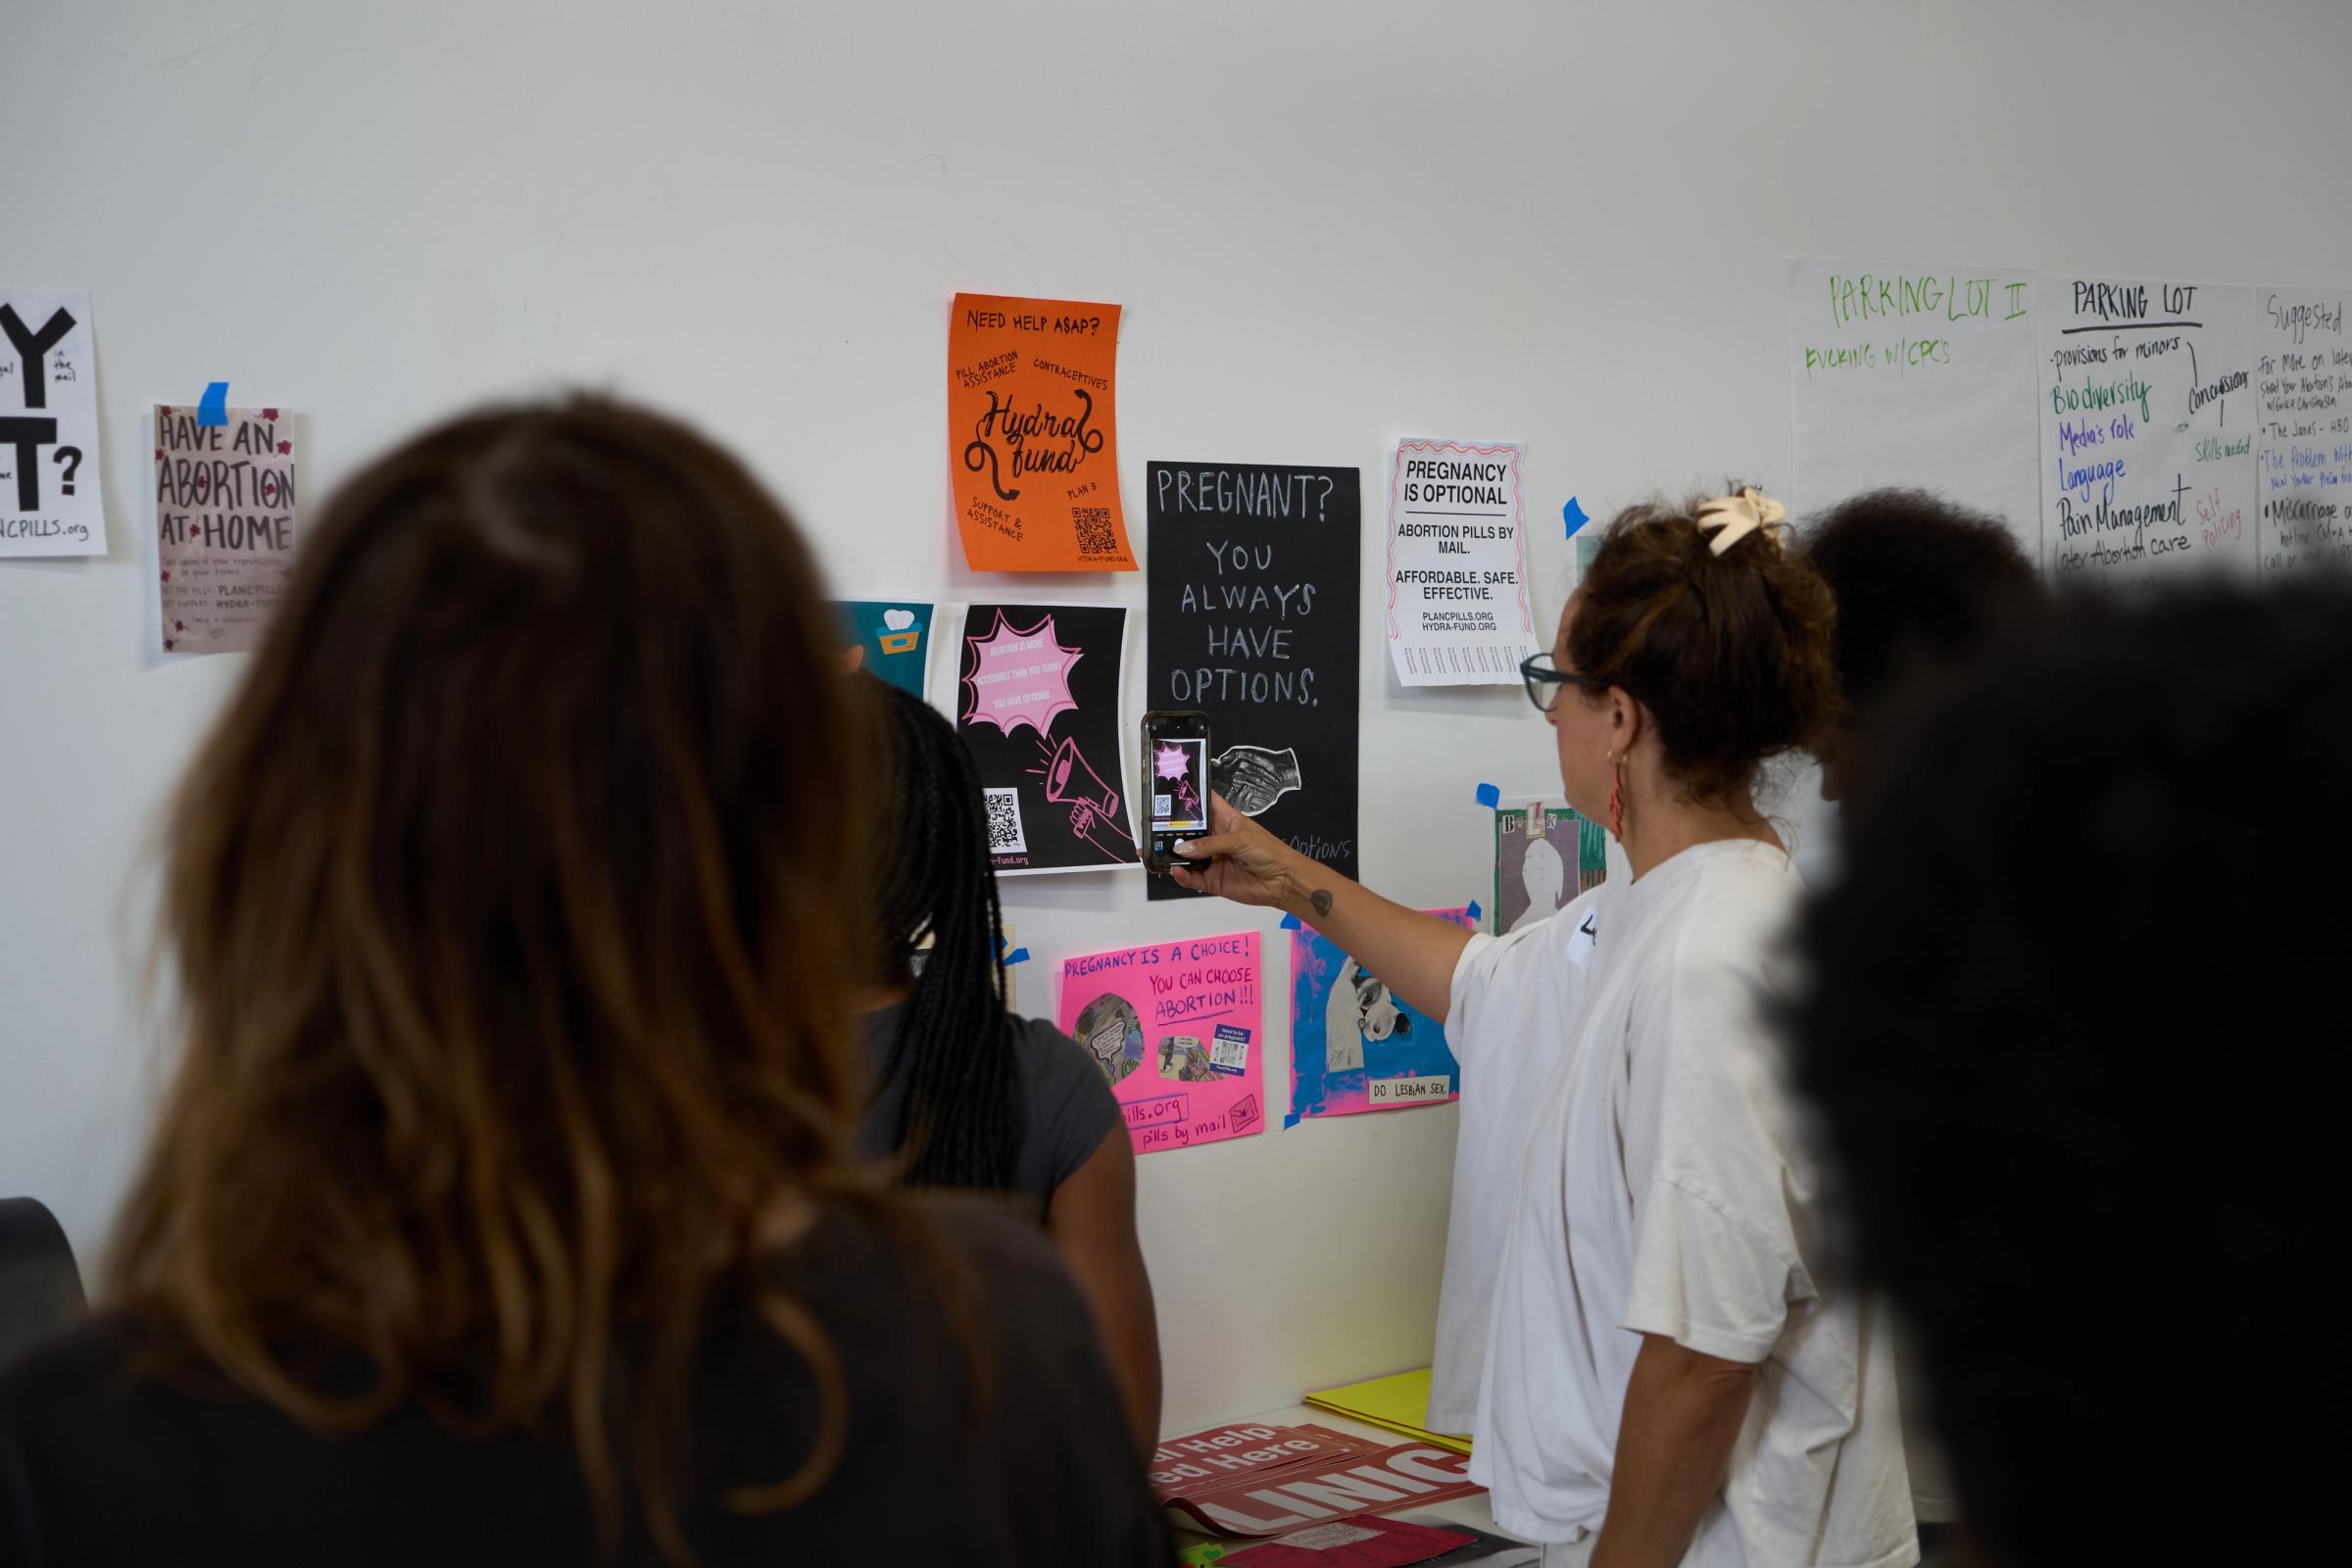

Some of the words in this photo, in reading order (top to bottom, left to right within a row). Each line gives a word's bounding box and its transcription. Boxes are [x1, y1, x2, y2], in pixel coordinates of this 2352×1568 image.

[1831, 274, 1944, 328] PARKING
[1948, 276, 1997, 321] LOT
[2072, 280, 2148, 321] PARKING
[2164, 283, 2198, 315] LOT
[967, 310, 1006, 333] NEED
[1013, 314, 1048, 332] HELP
[1054, 317, 1101, 336] ASAP?
[2267, 294, 2341, 345] Suggested
[2112, 335, 2129, 360] for
[2135, 335, 2180, 360] minors
[956, 366, 975, 380] PILL
[978, 350, 1018, 371] ABORTION
[963, 362, 1016, 389] ASSISTANCE
[1033, 359, 1108, 391] CONTRACEPTIVES
[983, 390, 1079, 445] Hydra
[2110, 414, 2135, 440] role
[2269, 422, 2287, 441] The
[160, 415, 222, 451] HAVE
[232, 420, 273, 456] AN
[1011, 439, 1077, 478] fund
[1406, 461, 1507, 482] PREGNANCY
[157, 455, 295, 511] ABORTION
[1067, 484, 1089, 501] PLAN
[1091, 481, 1098, 491] B
[1157, 469, 1334, 522] PREGNANT?
[1404, 483, 1418, 502] IS
[1423, 484, 1507, 505] OPTIONAL
[2058, 457, 2127, 507] Language
[966, 509, 1024, 542] ASSISTANCE
[972, 497, 1010, 520] SUPPORT
[1013, 517, 1022, 531] &
[2056, 496, 2092, 542] Pain
[2096, 473, 2192, 547] Management
[161, 513, 190, 546] AT
[203, 514, 291, 551] HOME
[1397, 523, 1459, 538] ABORTION
[1463, 525, 1495, 539] PILLS
[1498, 526, 1514, 539] BY
[1205, 540, 1272, 575] YOU
[1439, 541, 1470, 555] MAIL.
[2090, 536, 2146, 566] Abortion
[1396, 569, 1481, 584] AFFORDABLE.
[1484, 571, 1519, 584] SAFE.
[1181, 583, 1316, 620] ALWAYS
[1423, 587, 1494, 600] EFFECTIVE.
[1422, 612, 1494, 621] PLANCPILLS.ORG
[1422, 622, 1497, 631] HYDRA-FUND.ORG
[1207, 624, 1294, 660] HAVE
[1171, 667, 1319, 707] OPTIONS.
[1064, 952, 1137, 979] PREGNANCY
[1141, 949, 1159, 965] IS
[1171, 947, 1182, 961] A
[1150, 974, 1174, 996] YOU
[1180, 968, 1201, 989] CAN
[1206, 967, 1253, 984] CHOOSE
[1374, 1084, 1387, 1097] DO
[1142, 1129, 1169, 1150] pills
[1175, 1125, 1189, 1145] by
[1195, 1113, 1226, 1136] mail
[1177, 1427, 1277, 1453] Help
[1201, 1440, 1320, 1470] Here
[1197, 1448, 1470, 1531] LINIC
